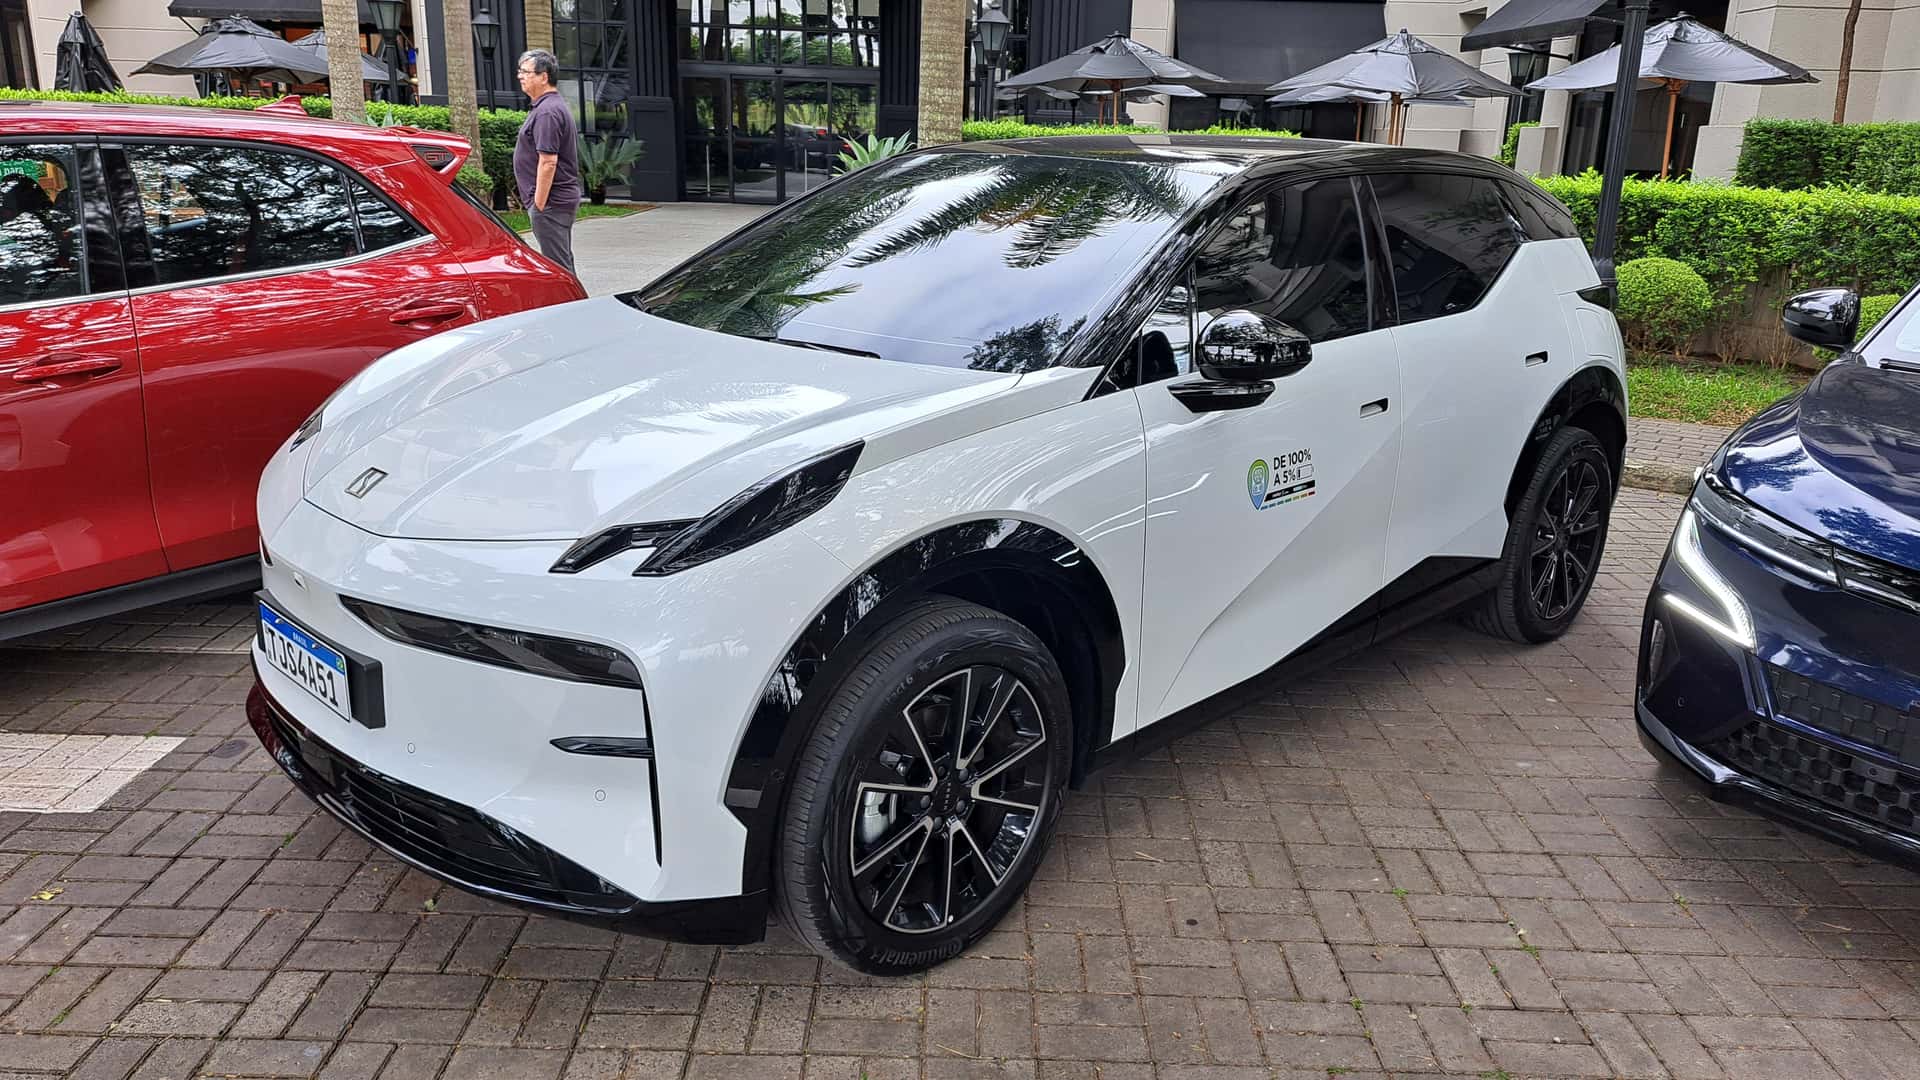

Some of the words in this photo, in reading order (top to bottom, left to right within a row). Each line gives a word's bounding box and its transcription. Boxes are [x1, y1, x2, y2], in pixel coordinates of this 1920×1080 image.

[1273, 455, 1287, 470] DE
[1288, 448, 1311, 466] 100%
[1273, 473, 1281, 486] A
[1283, 469, 1296, 484] 5%
[267, 627, 338, 707] TJS4A51
